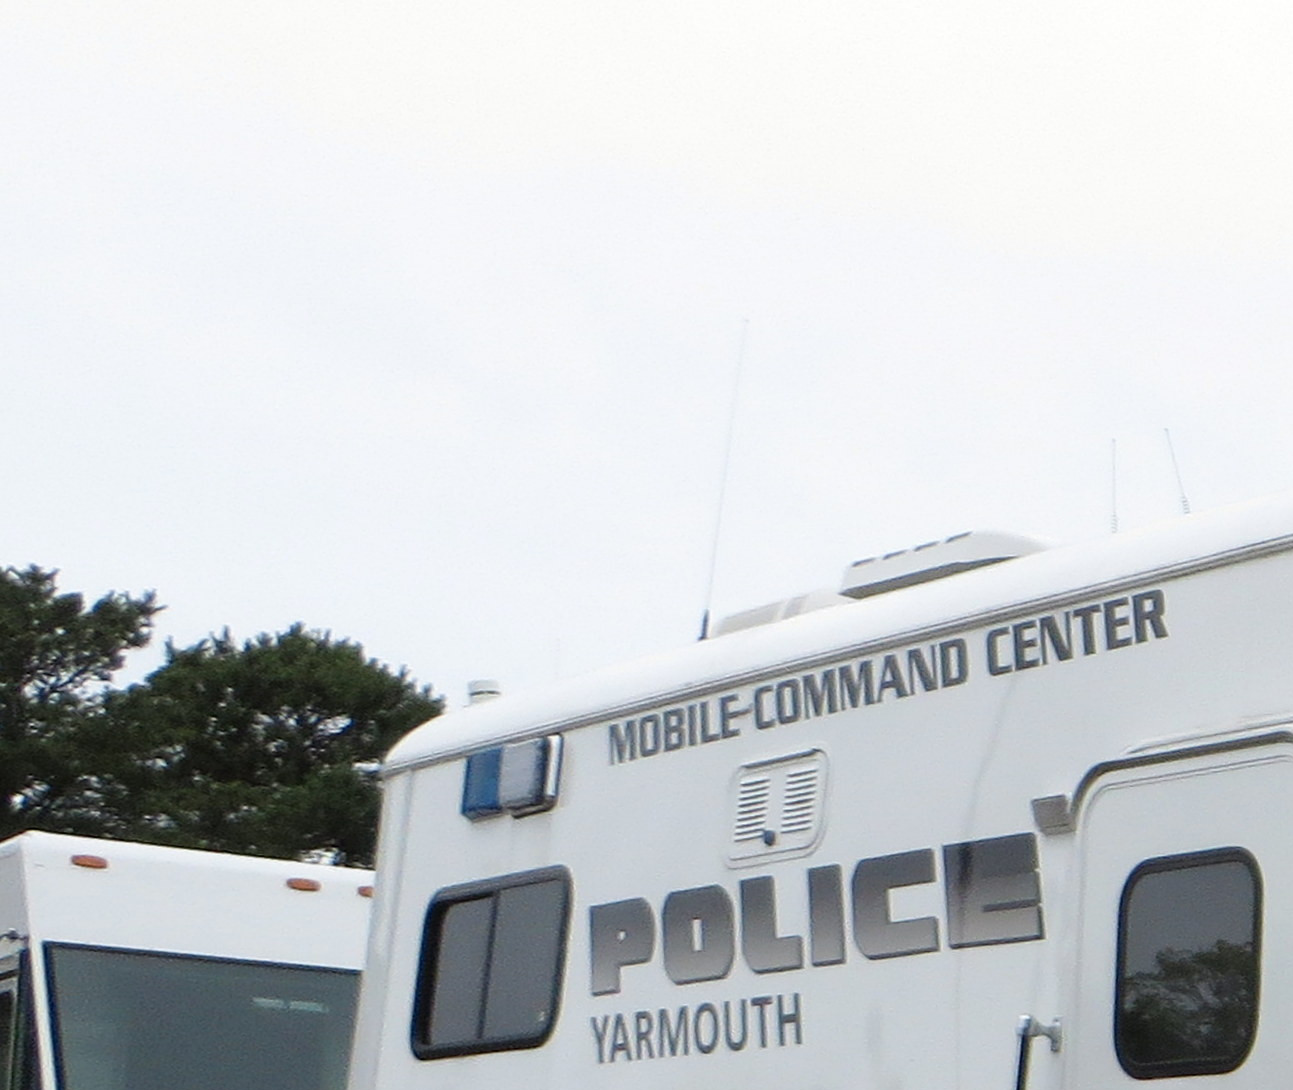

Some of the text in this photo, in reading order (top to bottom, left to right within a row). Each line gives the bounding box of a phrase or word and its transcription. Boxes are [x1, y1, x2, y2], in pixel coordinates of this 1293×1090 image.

[609, 588, 1169, 766] MOBILE-COMMAND CENTER
[589, 831, 1045, 997] POLICE
[590, 992, 803, 1065] YARMOUTH
